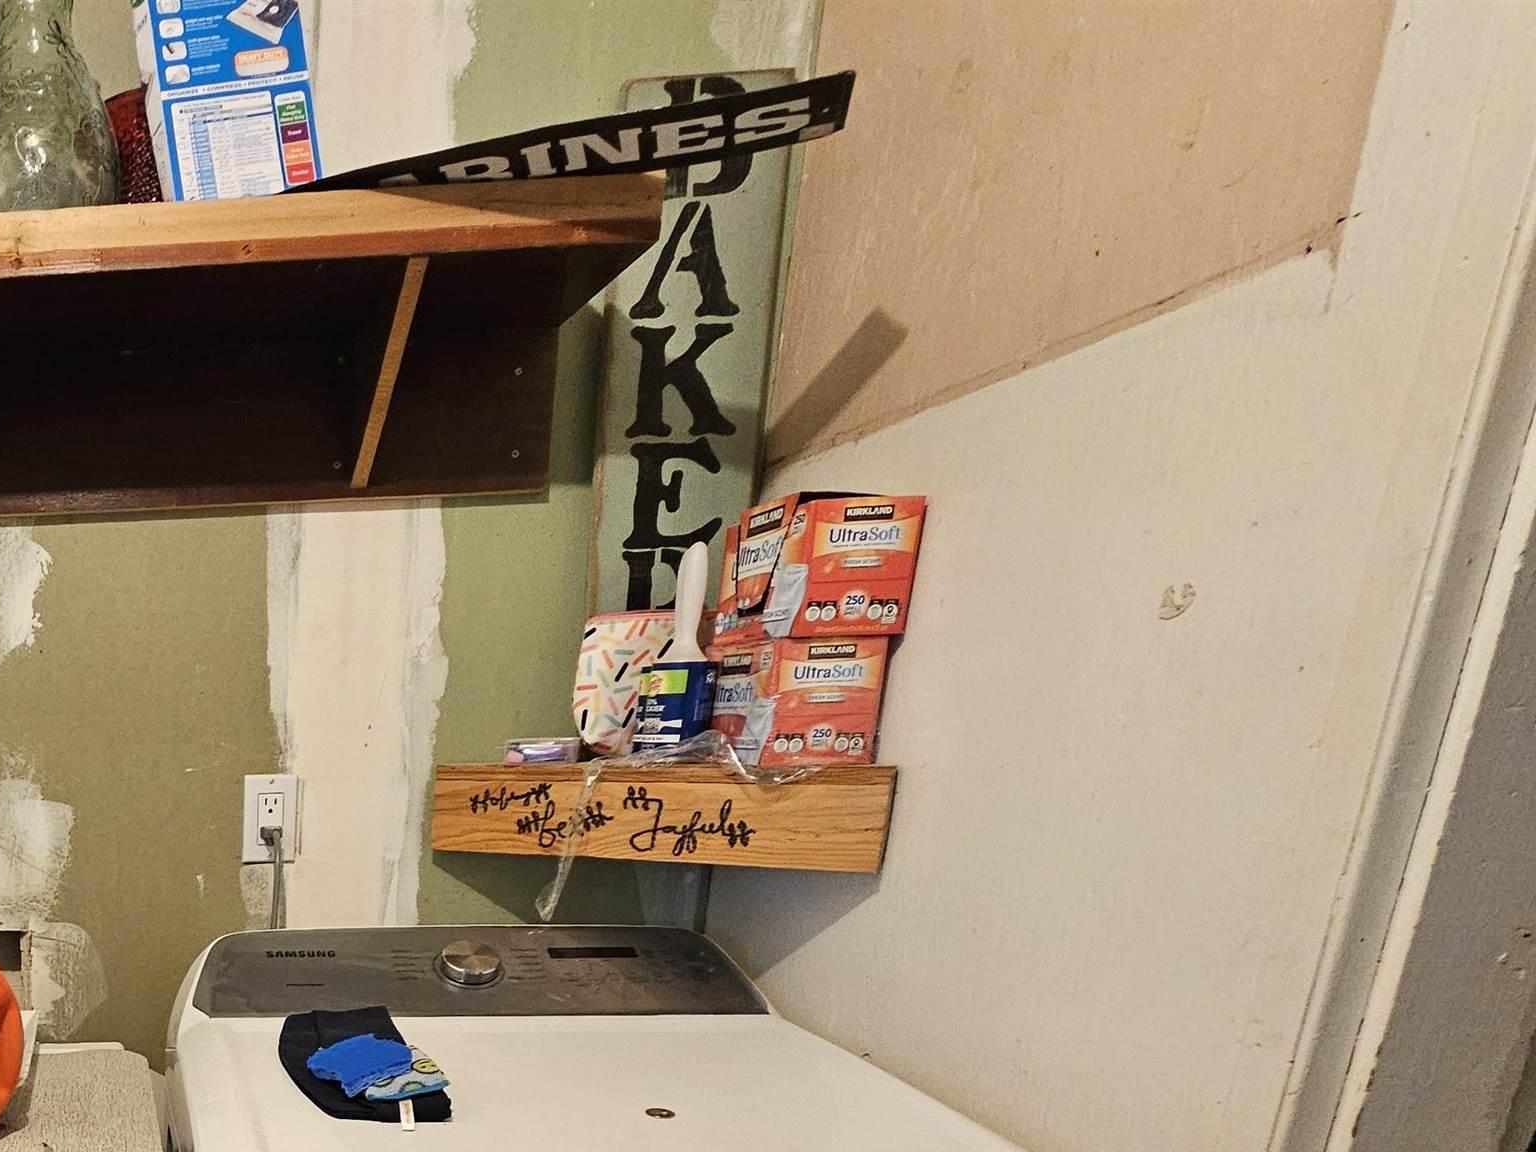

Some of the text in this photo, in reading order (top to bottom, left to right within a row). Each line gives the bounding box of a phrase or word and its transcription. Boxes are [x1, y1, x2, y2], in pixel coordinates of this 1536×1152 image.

[846, 506, 893, 516] KIRKLAND
[830, 525, 901, 544] UltraSoft
[845, 595, 865, 605] 250
[810, 645, 856, 655] KIRKLAND
[793, 664, 865, 680] UltraSoft
[812, 728, 832, 738] 250
[266, 950, 336, 958] SAMSUNG
